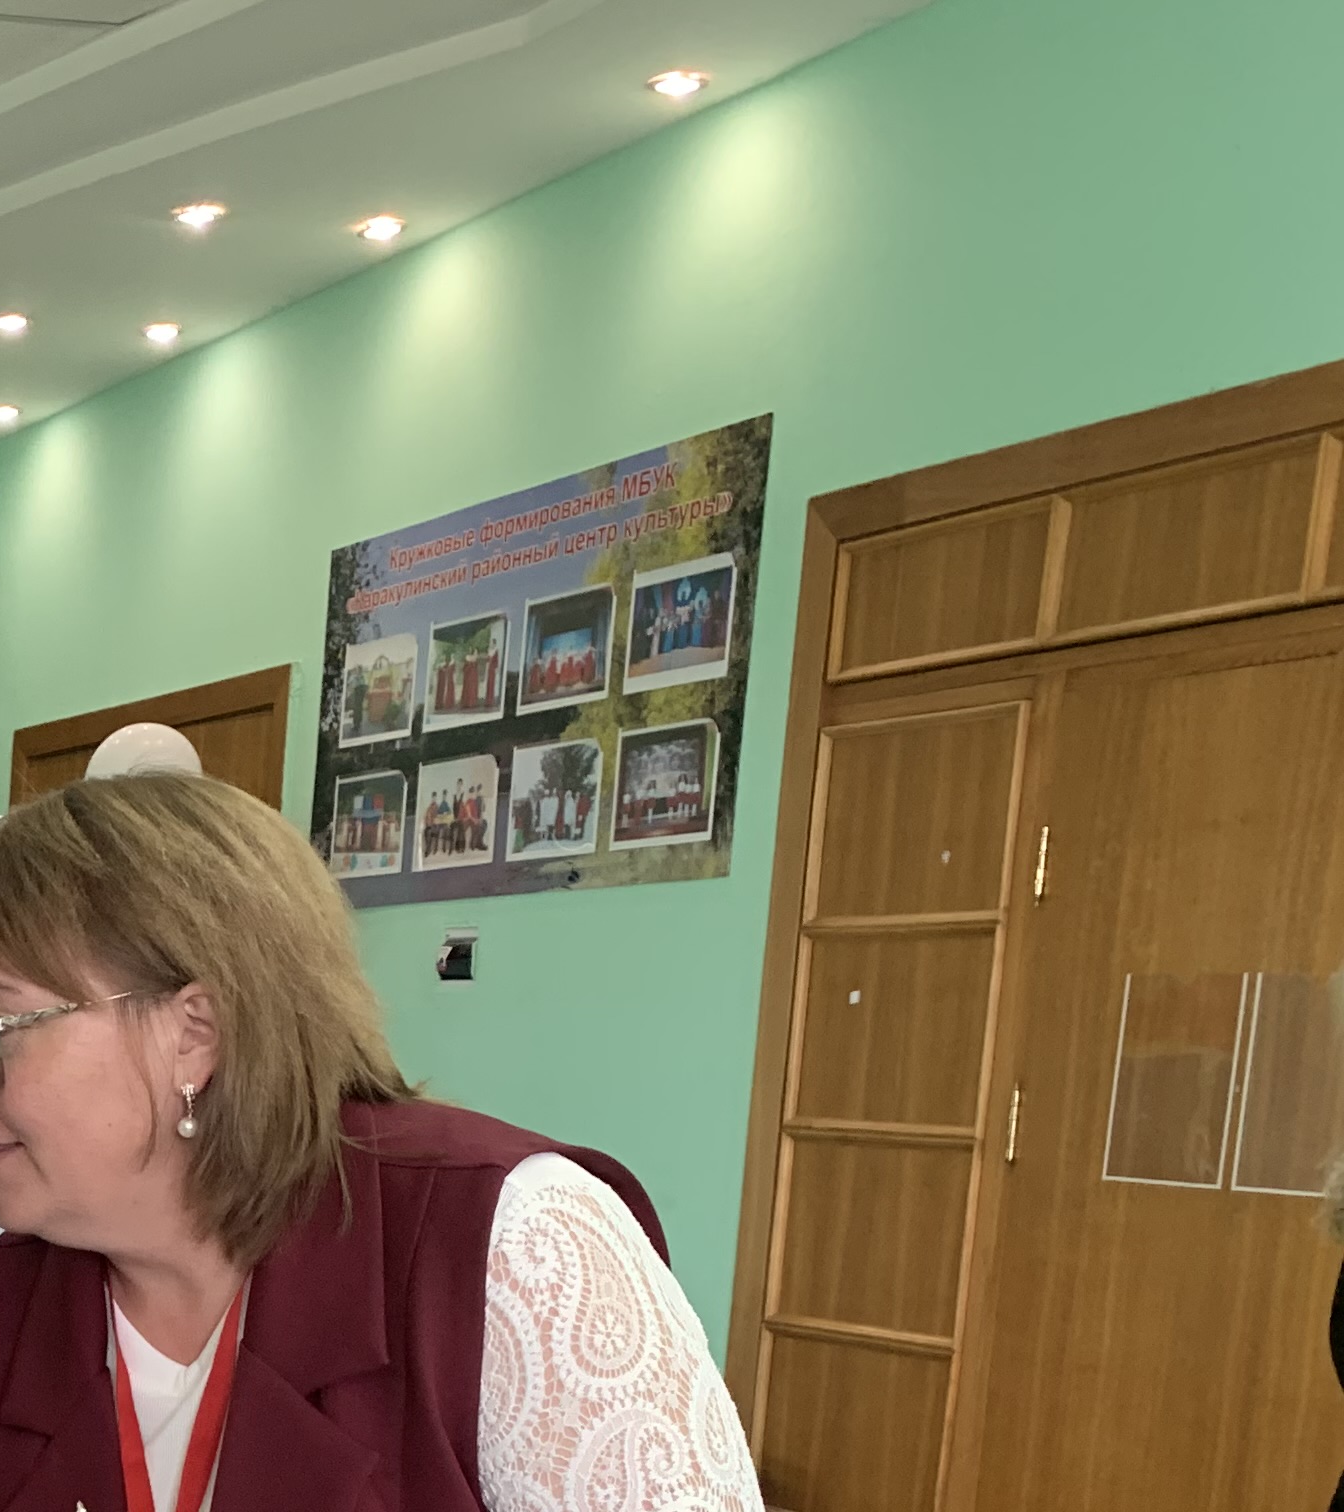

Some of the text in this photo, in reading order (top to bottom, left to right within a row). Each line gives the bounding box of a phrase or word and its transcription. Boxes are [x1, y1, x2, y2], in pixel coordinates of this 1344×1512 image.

[388, 462, 678, 572] Кружковые формирования МБУК
[471, 532, 560, 586] районный
[564, 522, 618, 555] центр
[623, 491, 734, 544] культуры»
